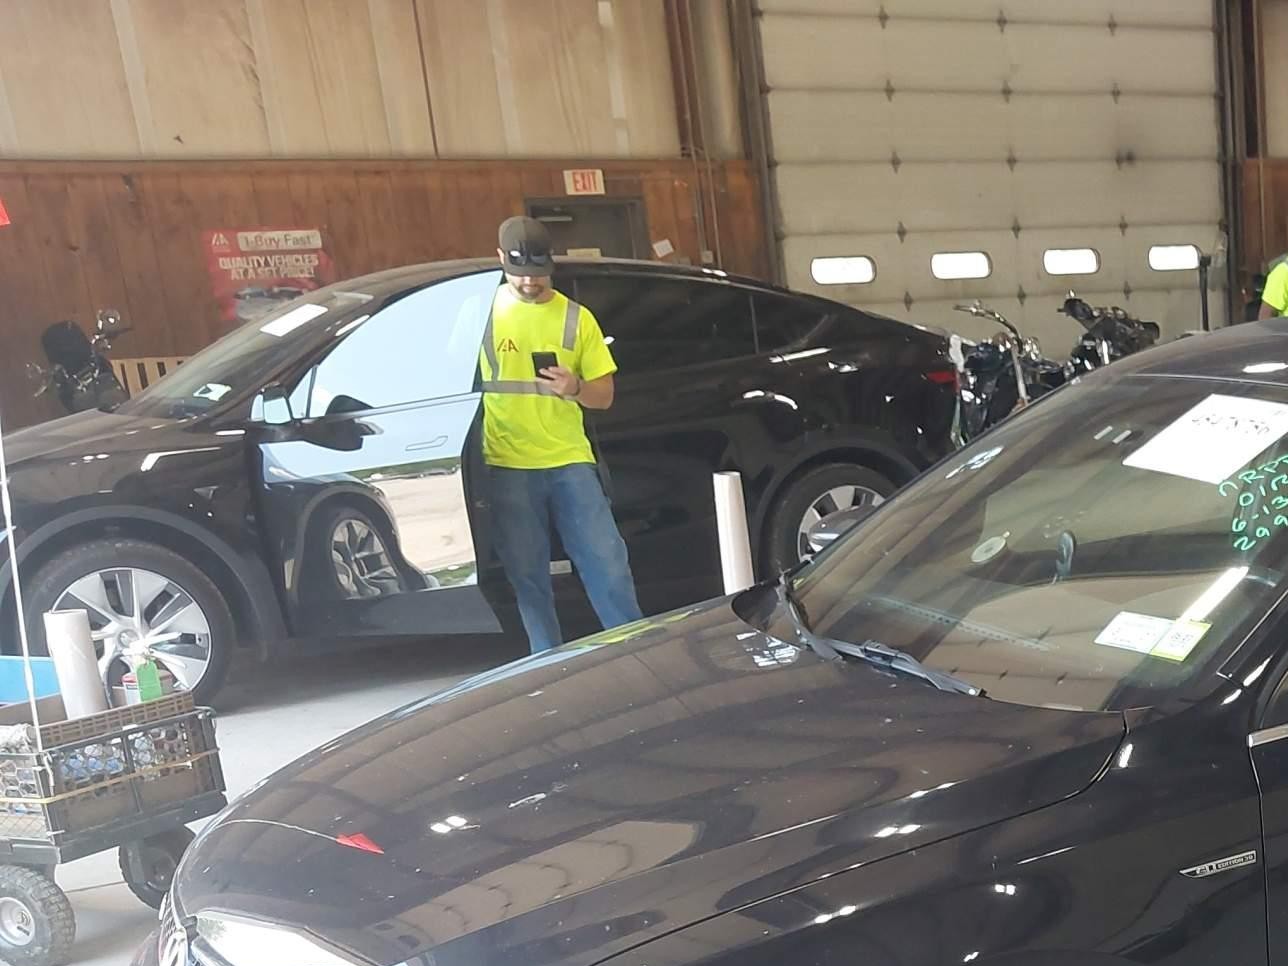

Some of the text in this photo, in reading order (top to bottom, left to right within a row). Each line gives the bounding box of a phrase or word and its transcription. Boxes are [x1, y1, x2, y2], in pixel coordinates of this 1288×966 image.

[572, 171, 598, 192] EXIT
[284, 233, 312, 245] Fast
[219, 254, 319, 269] QUALITY VEHICLES
